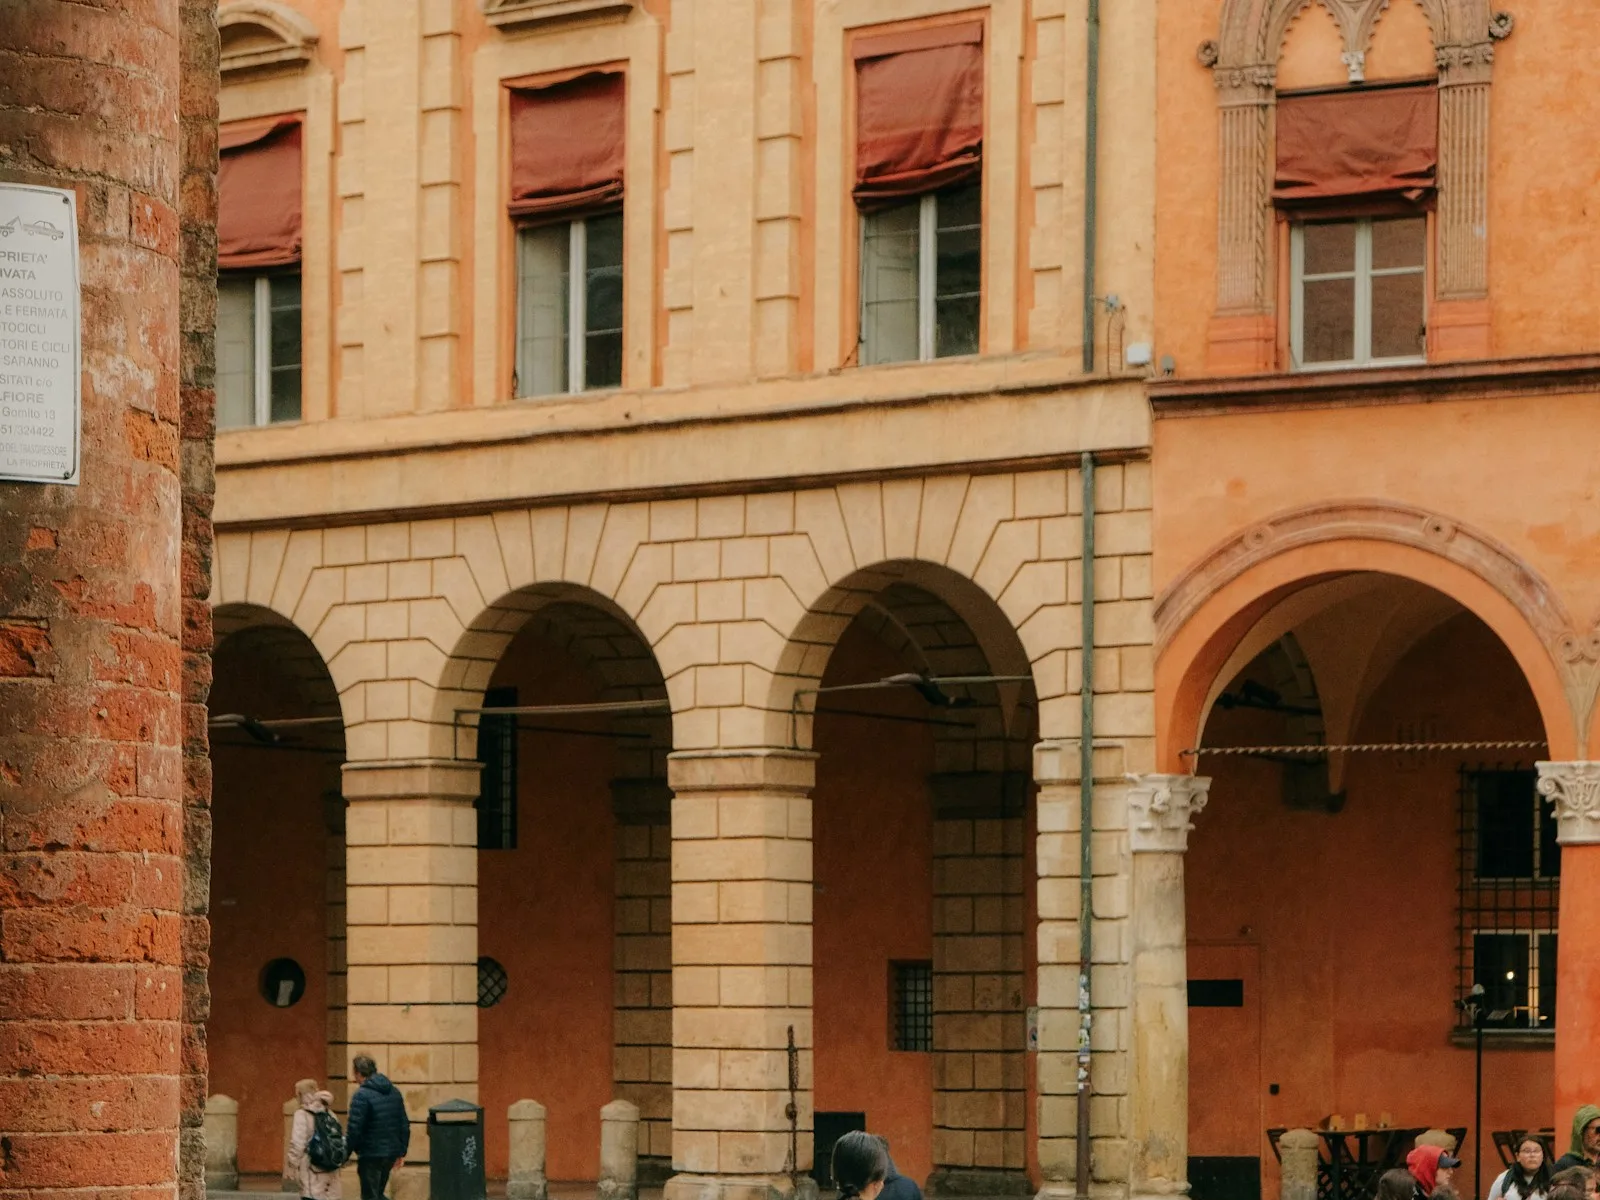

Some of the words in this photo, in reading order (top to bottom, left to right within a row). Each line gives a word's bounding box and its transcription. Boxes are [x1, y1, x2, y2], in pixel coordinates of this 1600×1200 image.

[2, 288, 63, 301] ASSOLUTO
[5, 305, 12, 315] E
[16, 305, 68, 319] FERMATA
[0, 321, 46, 334] TOCICLI
[0, 339, 27, 351] TORI
[31, 341, 38, 351] E
[42, 341, 69, 353] CICLI
[3, 355, 59, 369] SARANNO
[36, 378, 52, 388] c/o
[0, 391, 44, 403] FIORE
[2, 406, 40, 419] Gomito
